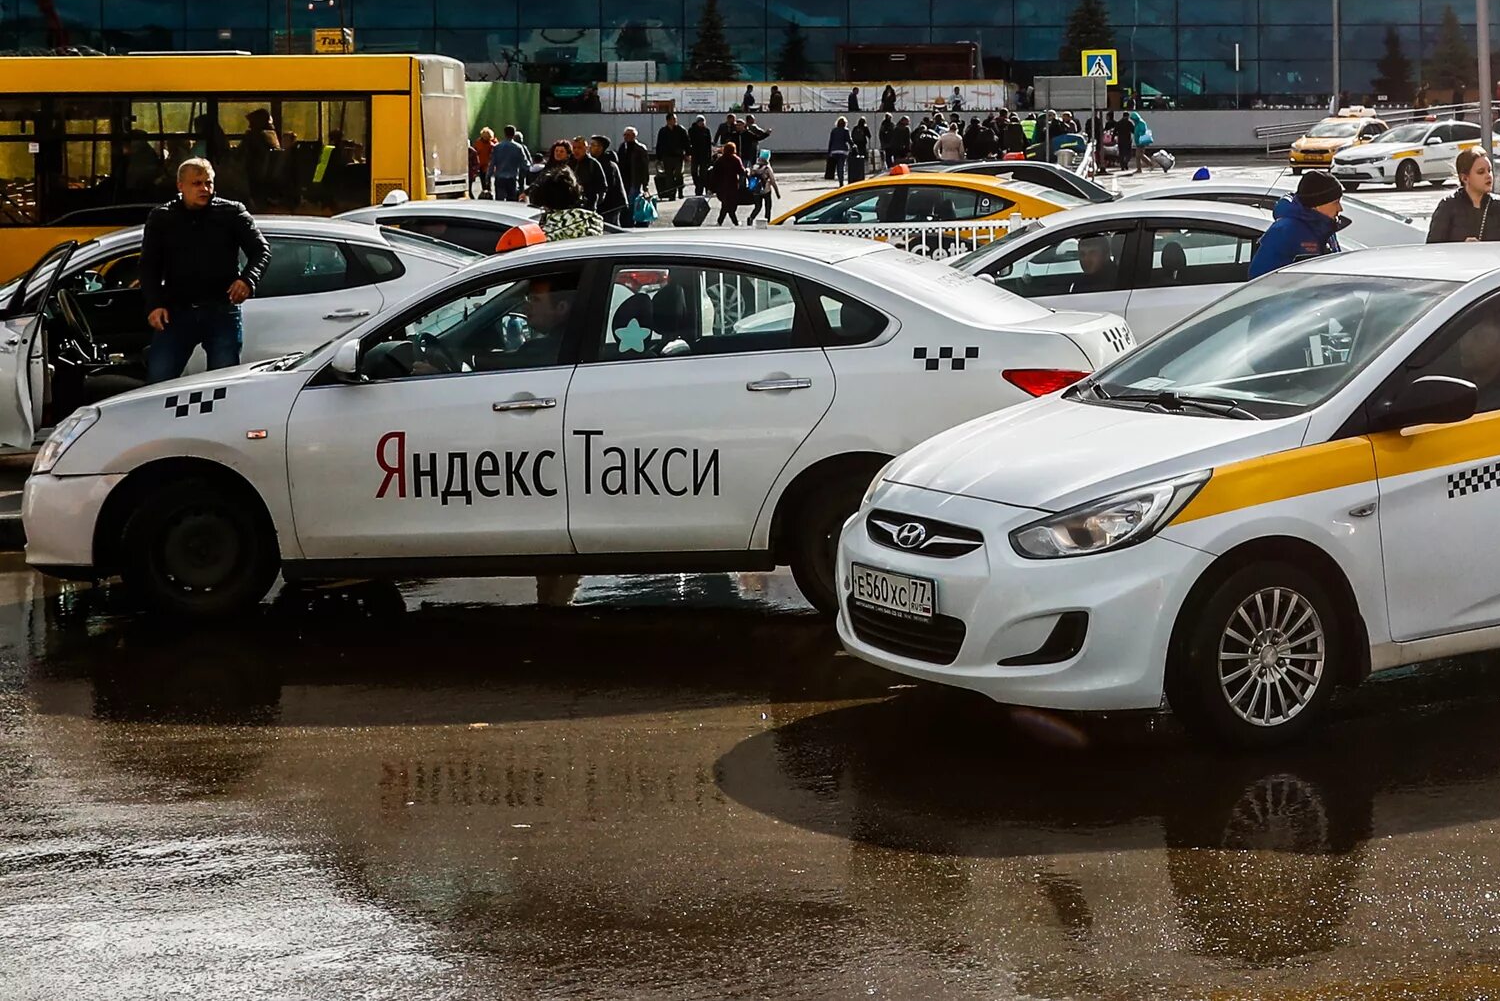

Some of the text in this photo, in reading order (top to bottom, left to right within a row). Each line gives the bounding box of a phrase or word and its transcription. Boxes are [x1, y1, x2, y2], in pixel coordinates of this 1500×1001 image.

[375, 429, 721, 506] Яндекс Такси
[911, 581, 926, 603] 77
